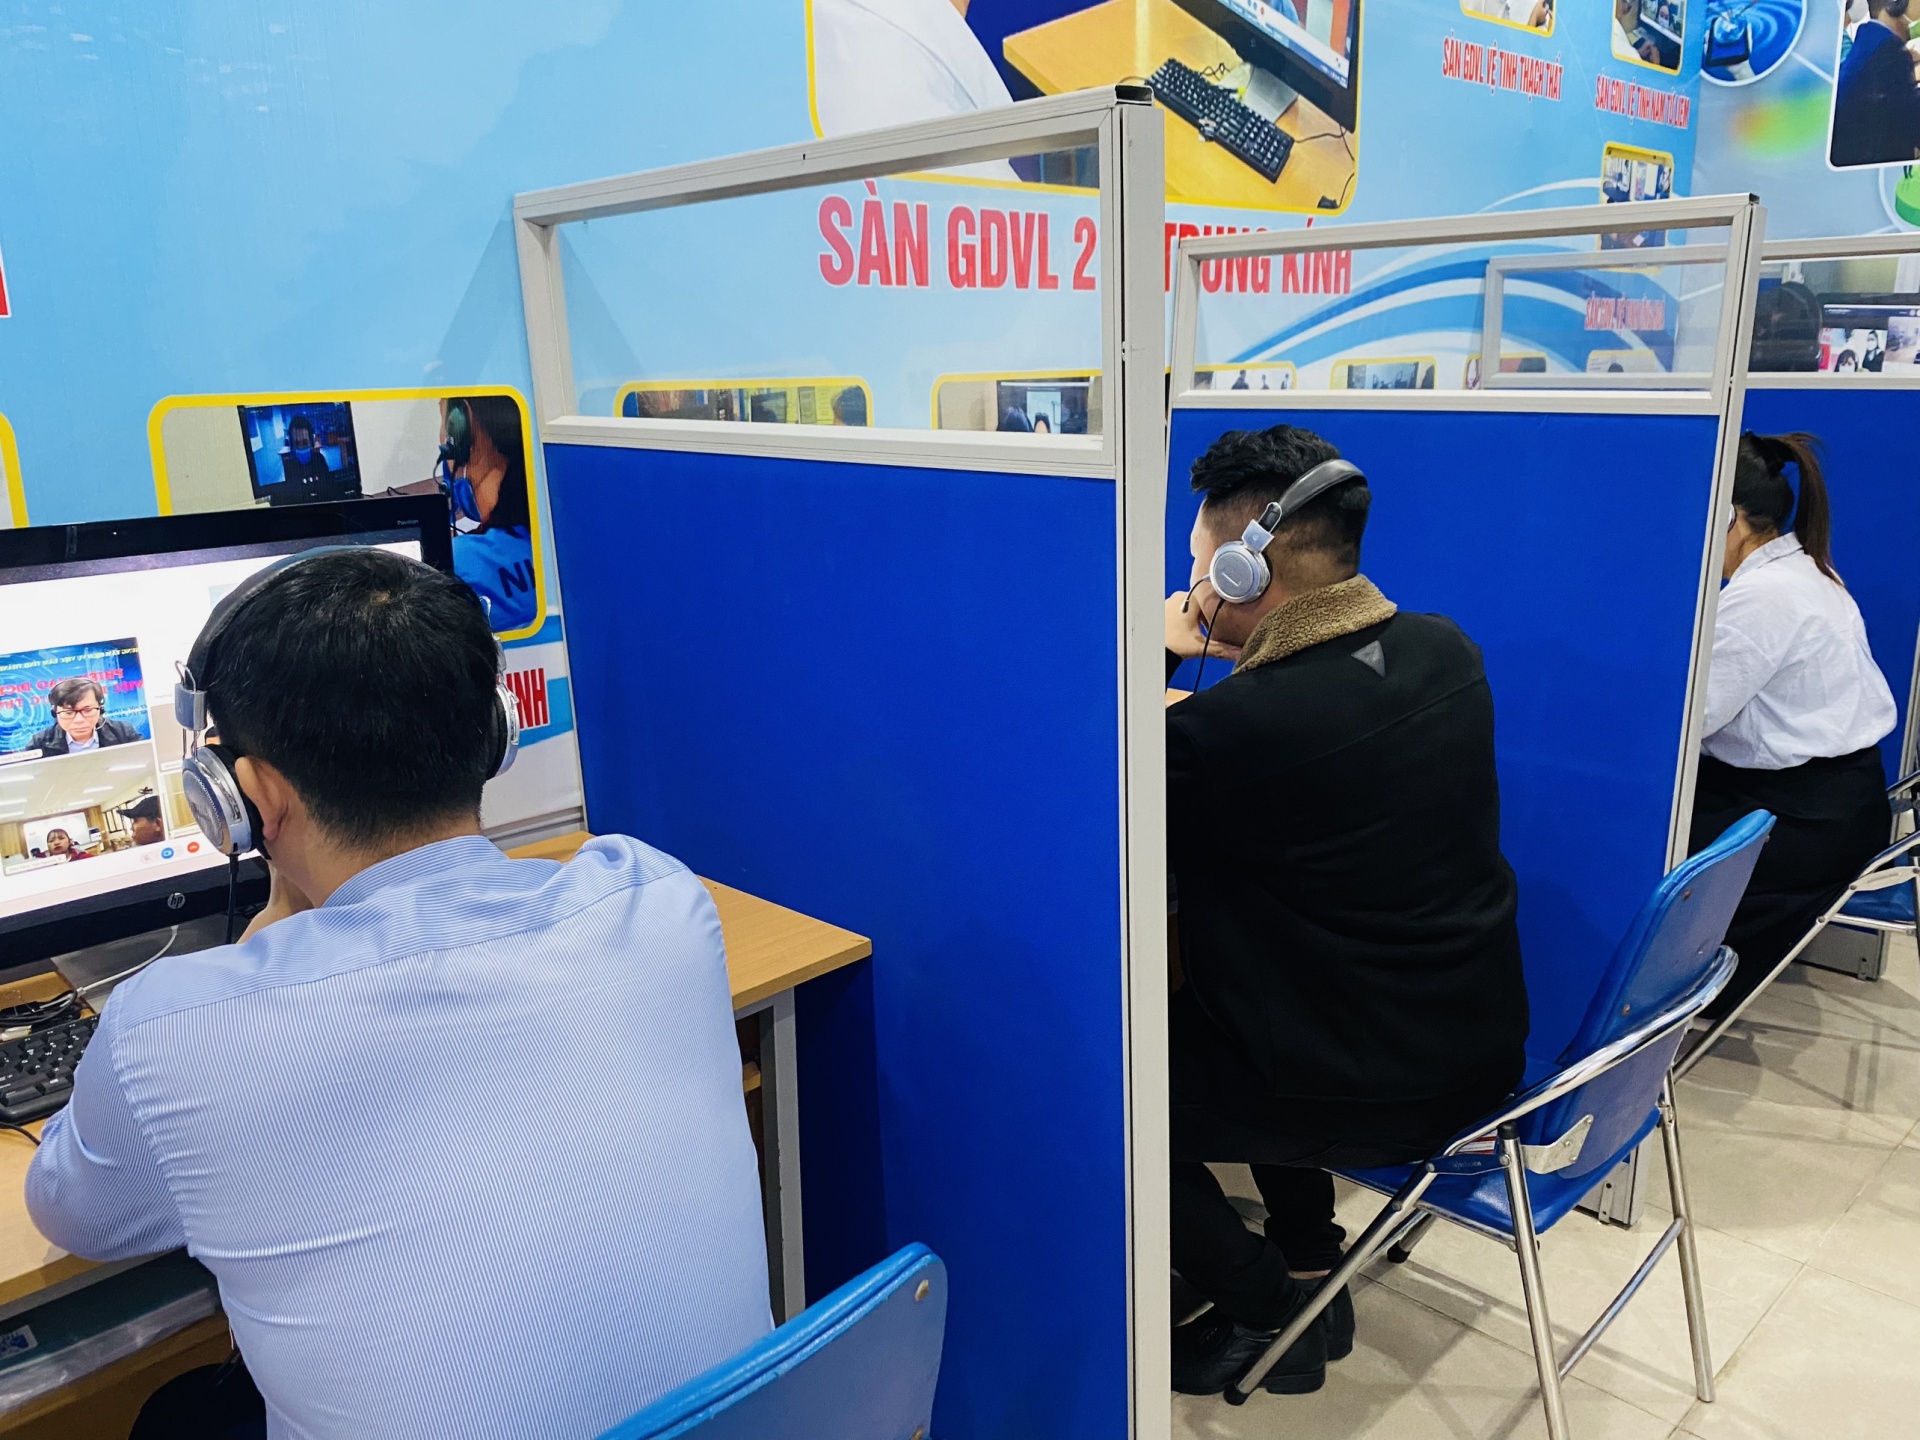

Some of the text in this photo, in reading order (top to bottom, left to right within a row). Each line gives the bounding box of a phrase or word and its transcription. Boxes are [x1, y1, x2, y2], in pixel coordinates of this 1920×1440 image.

[1443, 31, 1461, 78] SÀN
[1464, 42, 1483, 83] GDVL
[1500, 51, 1518, 90] TINH
[818, 179, 929, 286] SÀN
[946, 205, 1058, 290] GDVL
